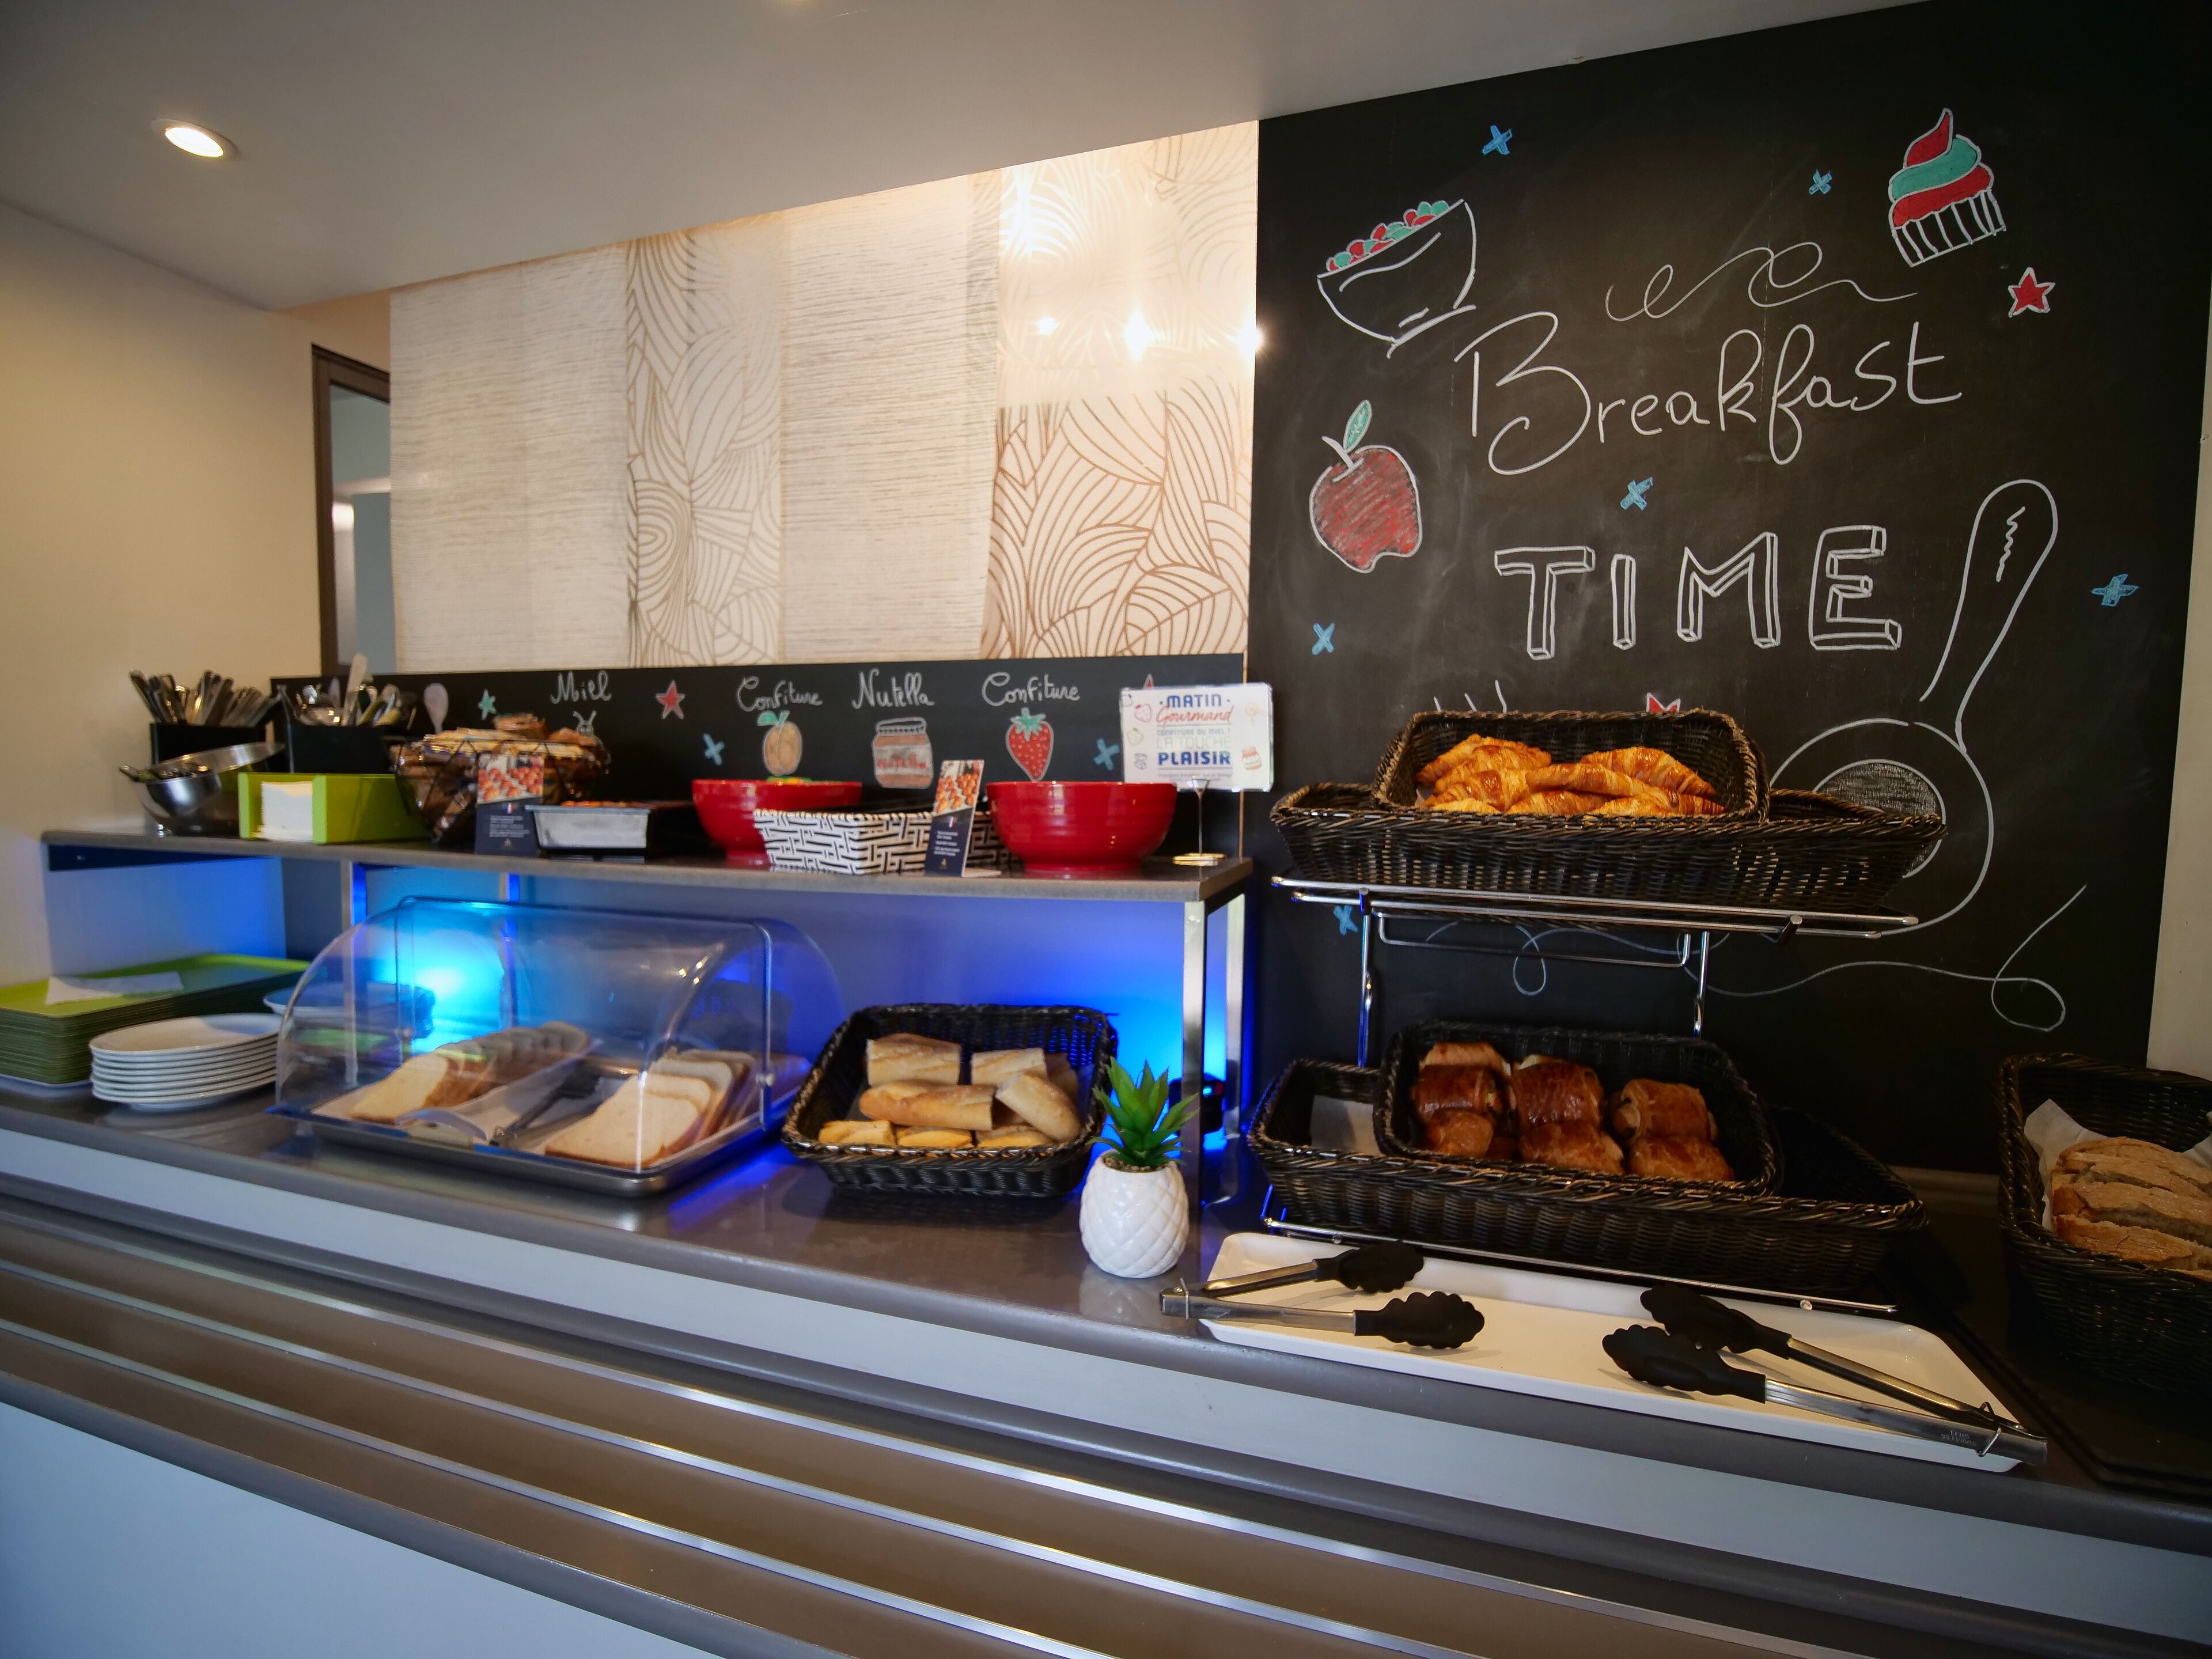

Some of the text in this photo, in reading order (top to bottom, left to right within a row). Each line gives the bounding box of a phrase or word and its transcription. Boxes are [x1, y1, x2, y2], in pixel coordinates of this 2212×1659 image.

[1454, 311, 1963, 475] Breakfast
[1494, 524, 1903, 661] TIME
[551, 670, 612, 704] Miel
[736, 676, 823, 712] Confiture
[851, 668, 934, 709] Nutella
[982, 672, 1080, 707] Confiture
[1167, 694, 1222, 708] MATIN
[1156, 704, 1234, 729] Gourmand
[1157, 751, 1231, 766] PLAISIR
